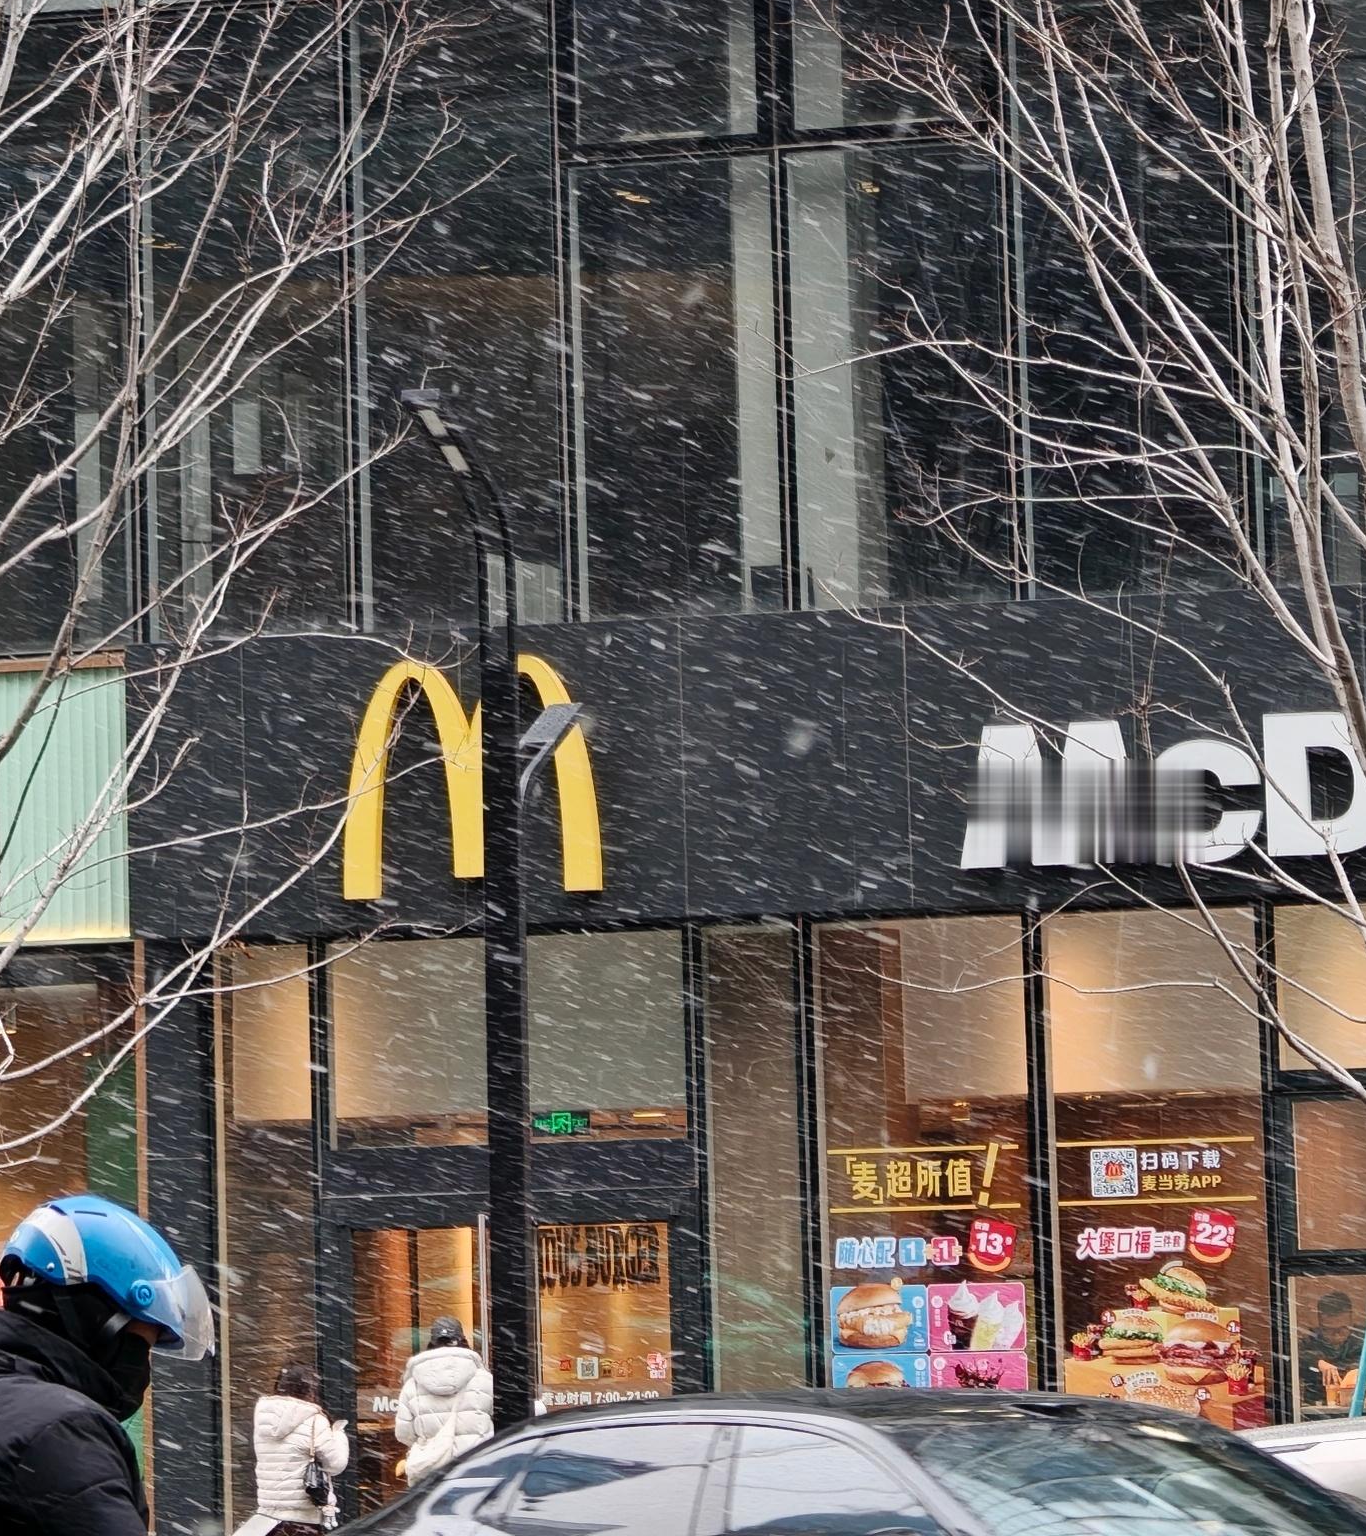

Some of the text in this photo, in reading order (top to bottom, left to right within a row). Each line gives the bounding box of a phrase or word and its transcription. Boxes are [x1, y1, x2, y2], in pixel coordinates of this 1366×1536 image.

[1140, 1150, 1222, 1171] 扫码下载
[1141, 1175, 1223, 1192] 麦当劳APP
[542, 1390, 592, 1406] 营业时间
